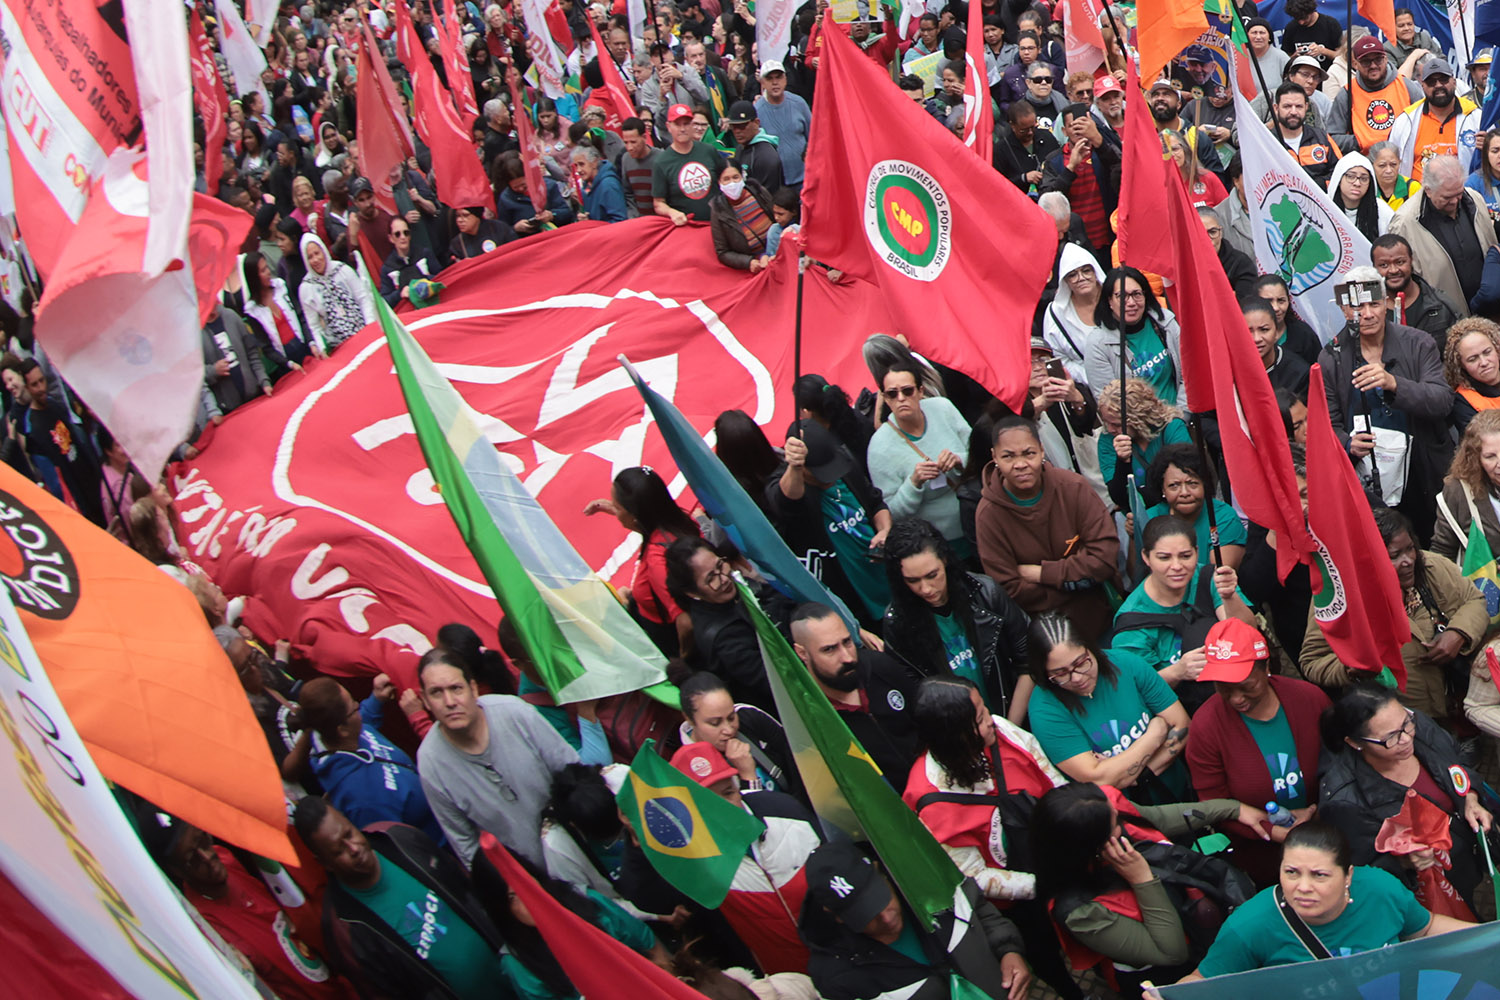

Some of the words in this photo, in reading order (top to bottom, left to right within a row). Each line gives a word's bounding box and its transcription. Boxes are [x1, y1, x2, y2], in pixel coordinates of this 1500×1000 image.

[56, 0, 133, 115] Trabalhadores
[69, 69, 87, 93] do
[1368, 100, 1389, 112] FORÇA
[1367, 114, 1394, 131] SINDICAL
[877, 165, 887, 175] DE
[889, 164, 946, 207] MOVIMENTOS
[934, 210, 950, 268] POPULARES
[891, 201, 924, 238] CMP
[886, 252, 919, 278] BRASIL
[416, 889, 440, 960] CEPROCI
